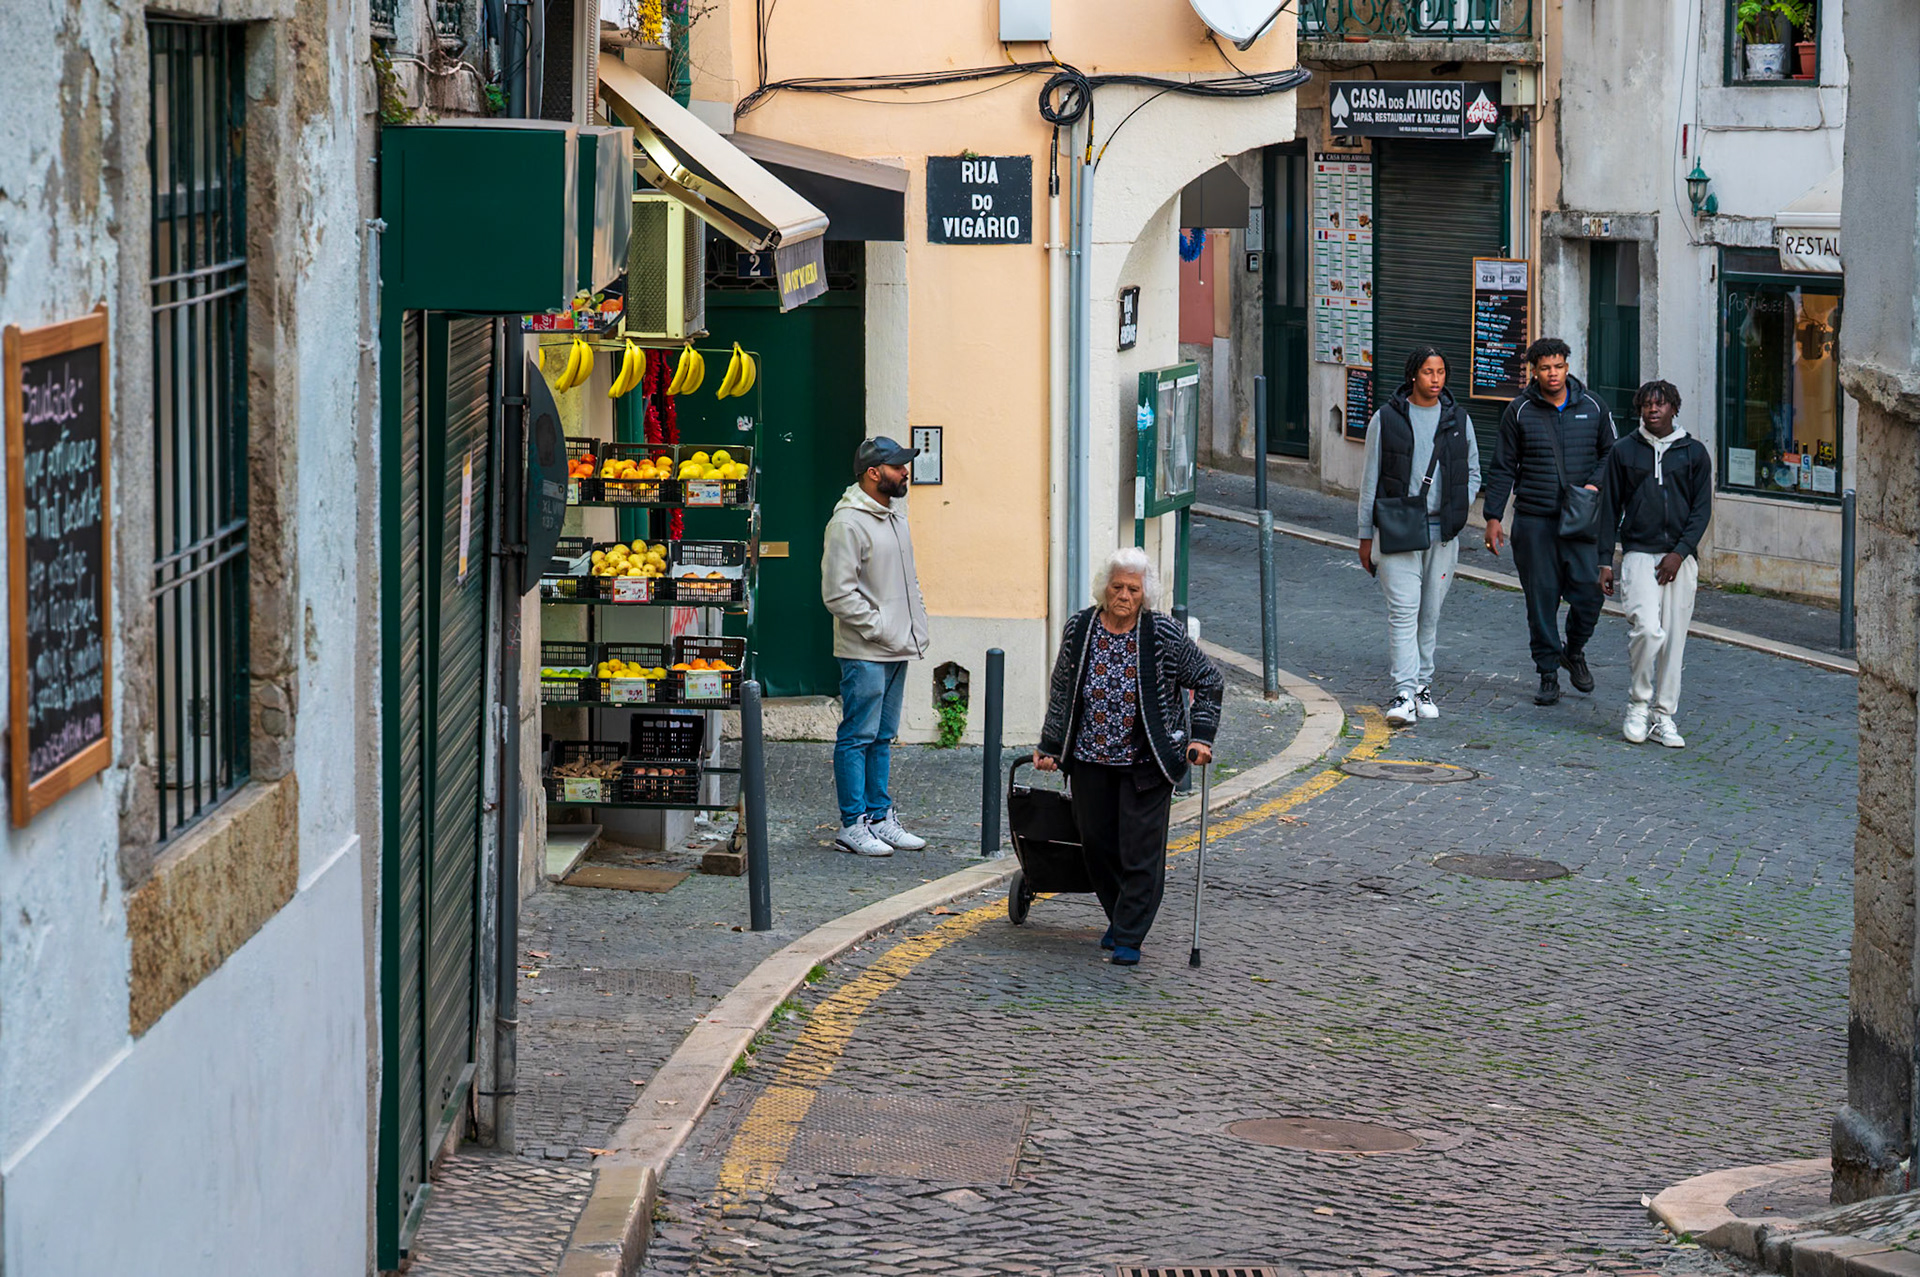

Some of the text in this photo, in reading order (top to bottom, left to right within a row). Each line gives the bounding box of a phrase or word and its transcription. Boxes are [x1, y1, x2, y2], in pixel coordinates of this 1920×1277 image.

[1350, 88, 1461, 111] CASA DOS AMIGOS
[1465, 101, 1496, 112] TAKE
[1352, 112, 1460, 125] TAPAS, RESTAURANT & TAKE AWAY
[1465, 114, 1498, 125] AWAY
[1326, 153, 1340, 161] CASA
[961, 160, 999, 184] RUA
[971, 193, 993, 211] DO
[942, 211, 1020, 239] VIGÁRIO
[749, 254, 761, 276] 2
